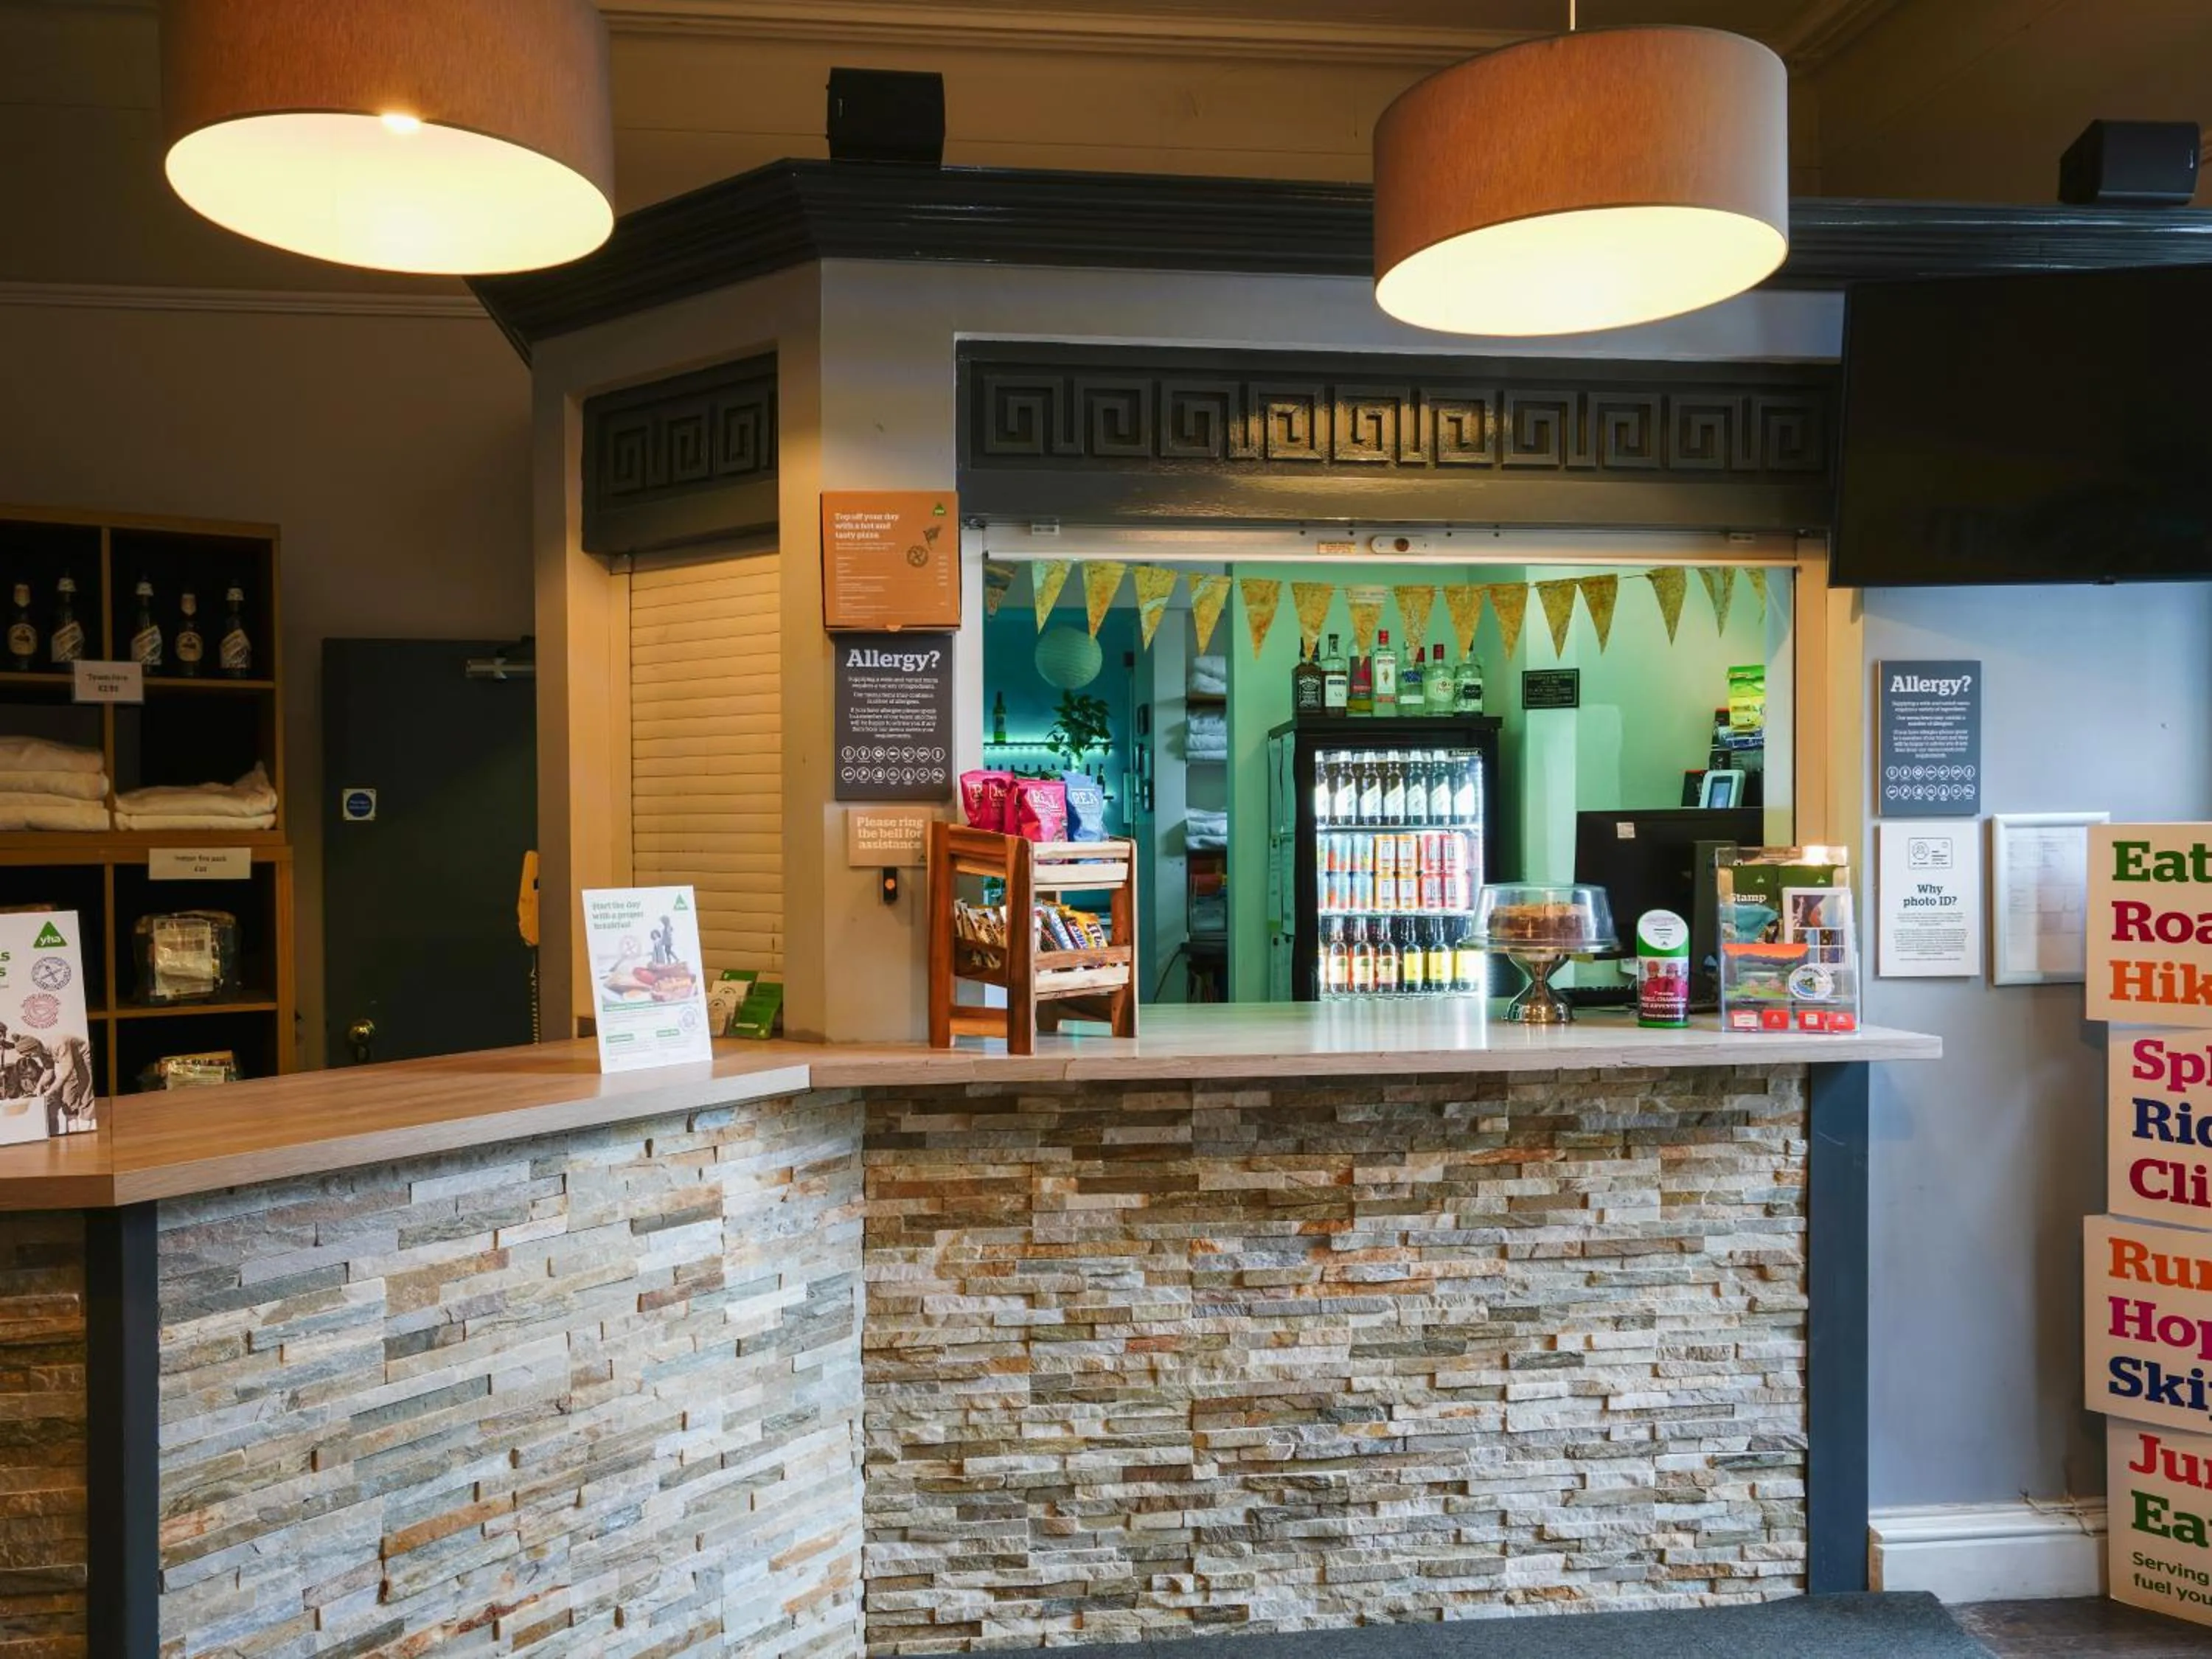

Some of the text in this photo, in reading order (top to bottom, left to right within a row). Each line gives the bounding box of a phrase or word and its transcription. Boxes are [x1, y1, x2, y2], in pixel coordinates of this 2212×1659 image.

[846, 649, 940, 672] Allergy?
[1890, 675, 1972, 695] Allergy?
[857, 816, 924, 830] Please ring
[858, 828, 922, 838] the bell for
[858, 840, 921, 849] assistance
[2112, 841, 2212, 883] Eat
[1730, 893, 1767, 902] Stamp
[1917, 884, 1943, 894] Why
[1903, 896, 1958, 908] photo ID?
[41, 934, 61, 945] yha
[2109, 959, 2212, 1006] Hik
[2129, 1158, 2211, 1208] Cli
[2109, 1356, 2212, 1420] Ski
[2129, 1433, 2212, 1491] Ju
[2131, 1489, 2212, 1548] Ea
[2132, 1551, 2209, 1587] Serving
[2133, 1573, 2212, 1606] fuel you
